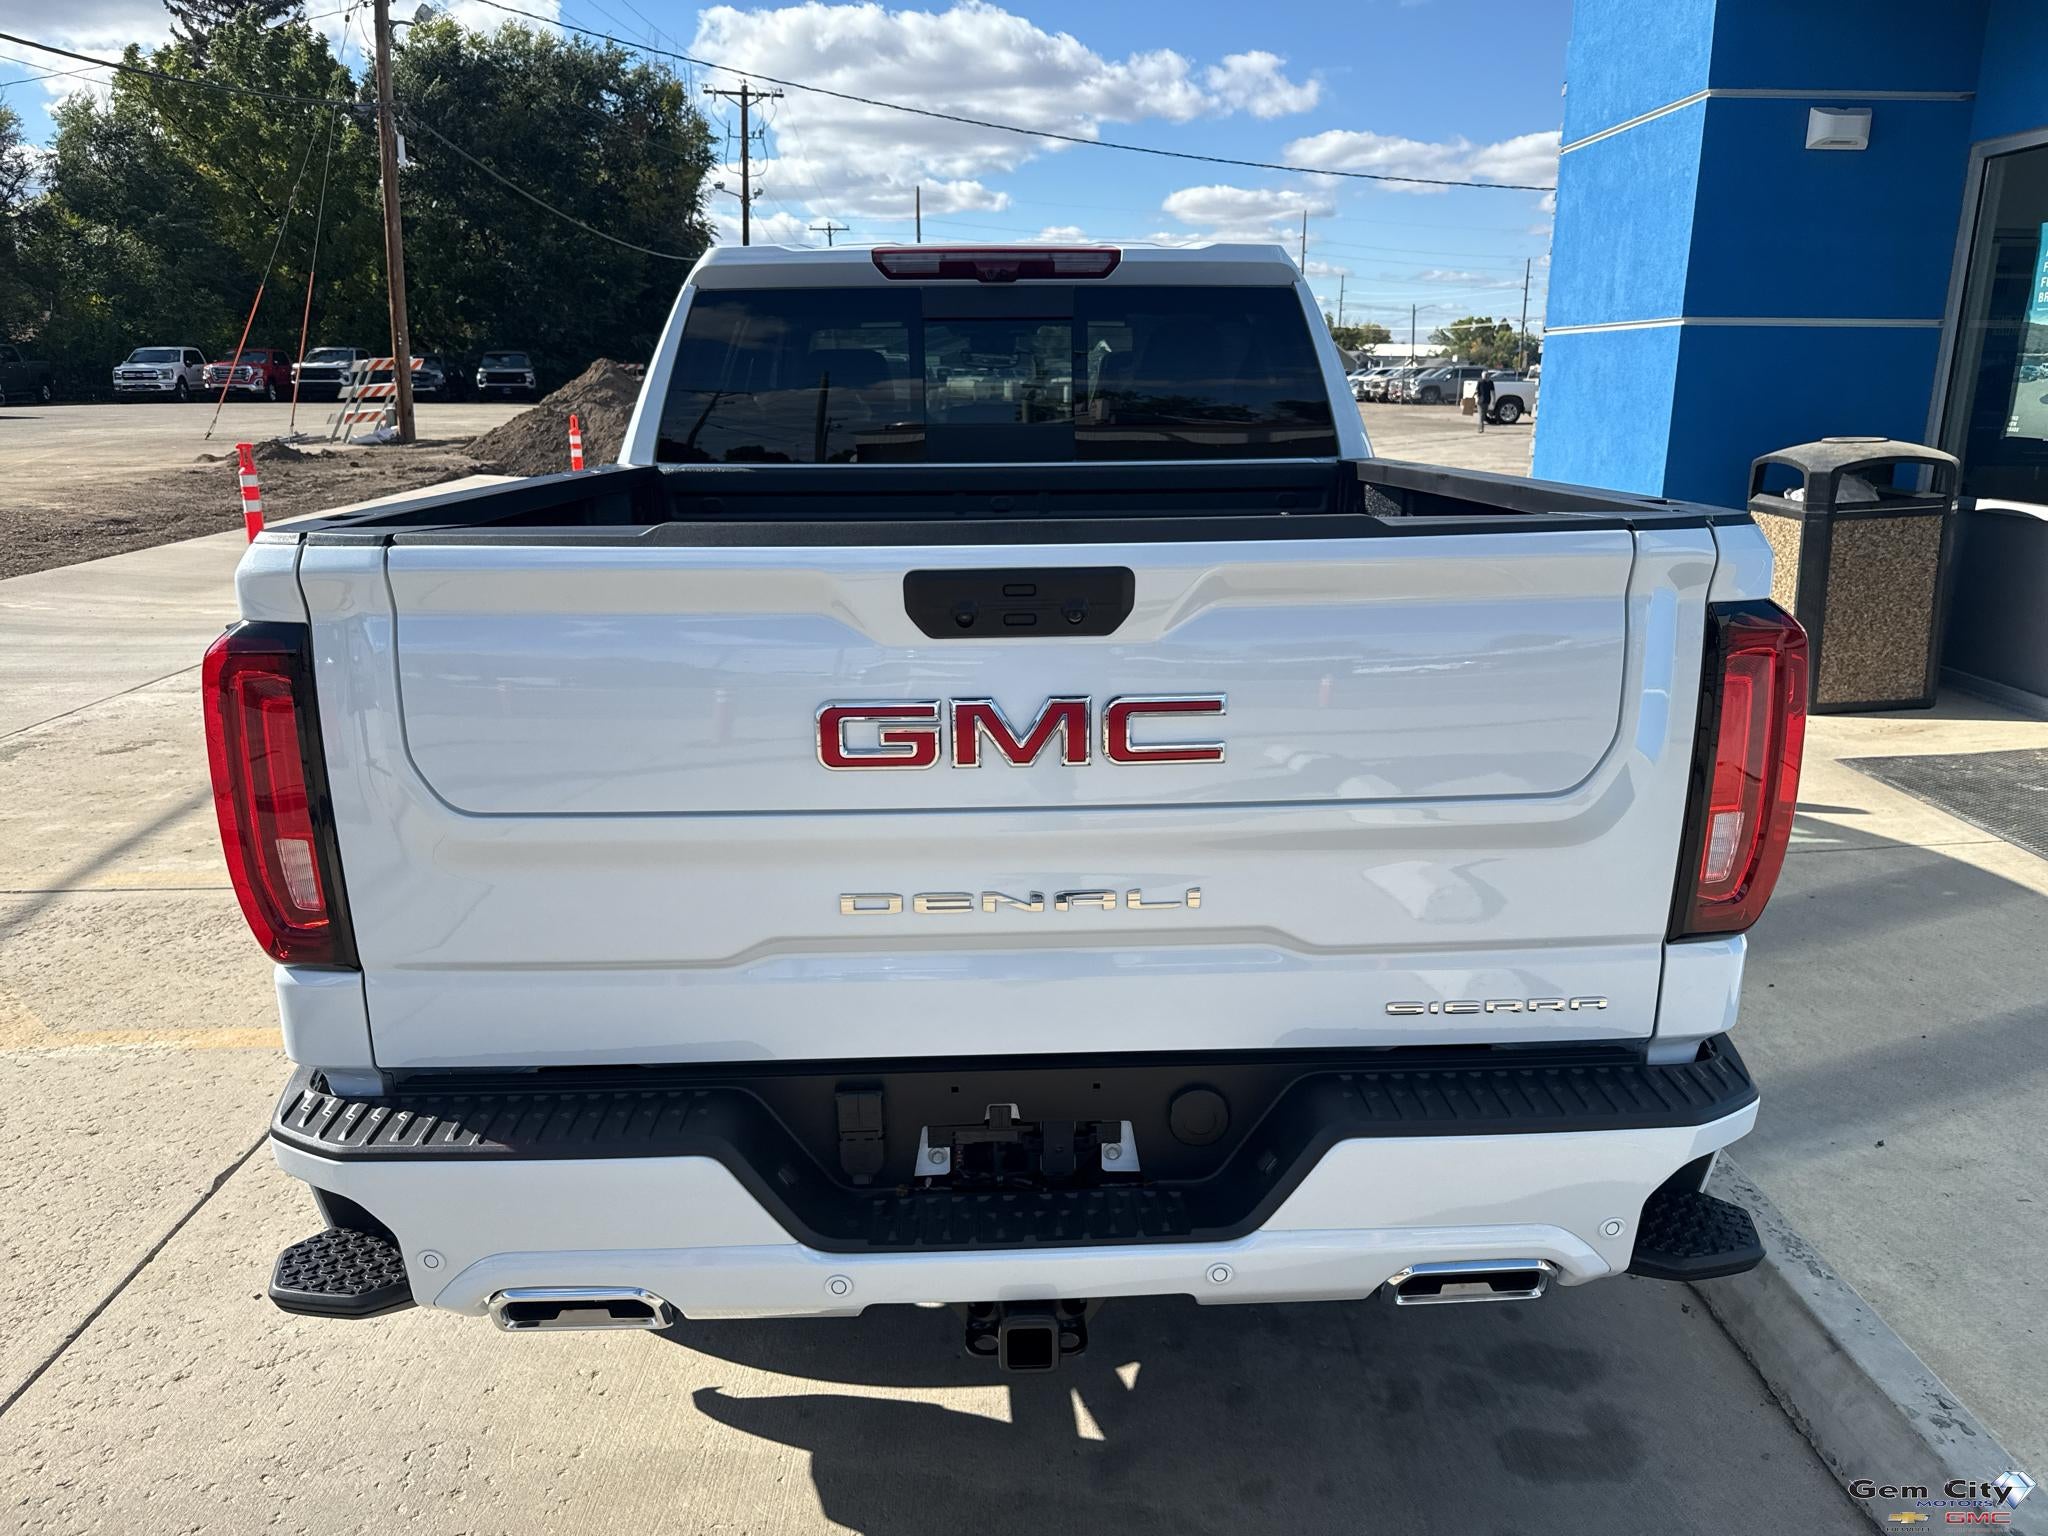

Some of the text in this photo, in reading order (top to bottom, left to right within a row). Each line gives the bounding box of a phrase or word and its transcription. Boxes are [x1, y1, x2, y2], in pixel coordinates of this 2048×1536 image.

[816, 693, 1227, 770] GMC
[840, 887, 1201, 915] DENALI
[1386, 996, 1608, 1015] SIERRA
